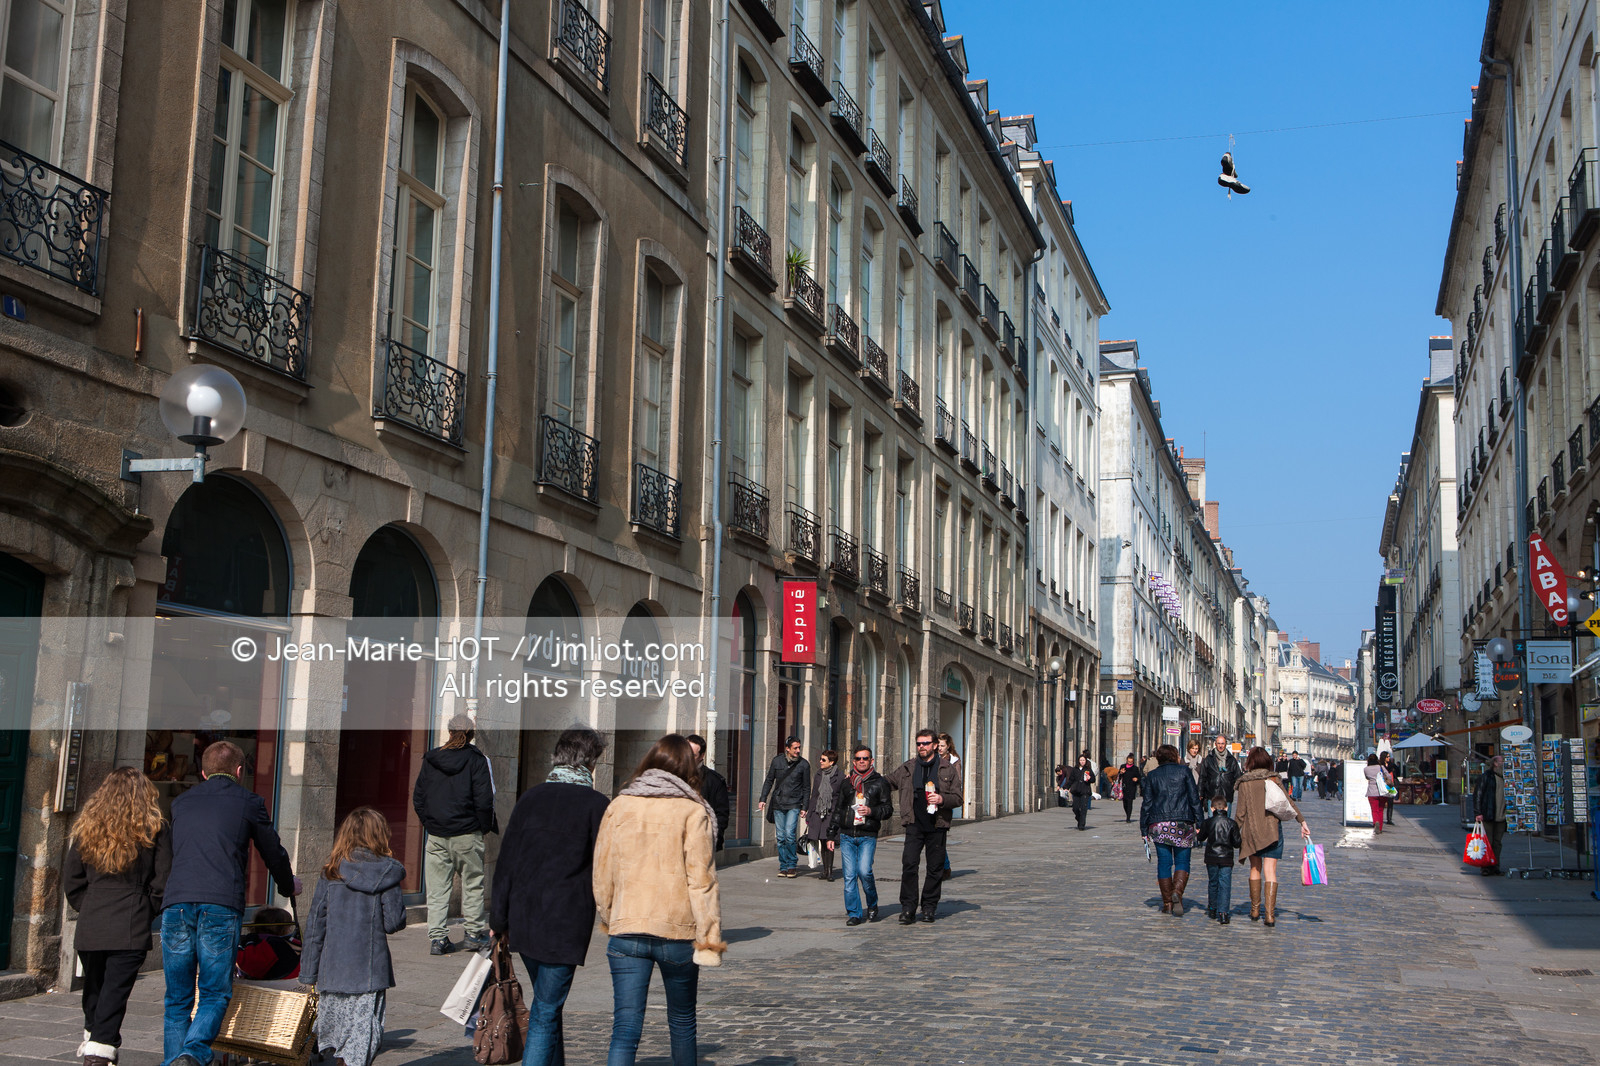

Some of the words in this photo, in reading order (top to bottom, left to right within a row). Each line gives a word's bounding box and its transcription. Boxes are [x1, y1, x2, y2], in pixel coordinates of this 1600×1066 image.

[1530, 538, 1568, 622] TABAC
[1383, 616, 1394, 667] MEGASTORE
[1529, 651, 1570, 665] Iona
[1191, 724, 1201, 732] SFR
